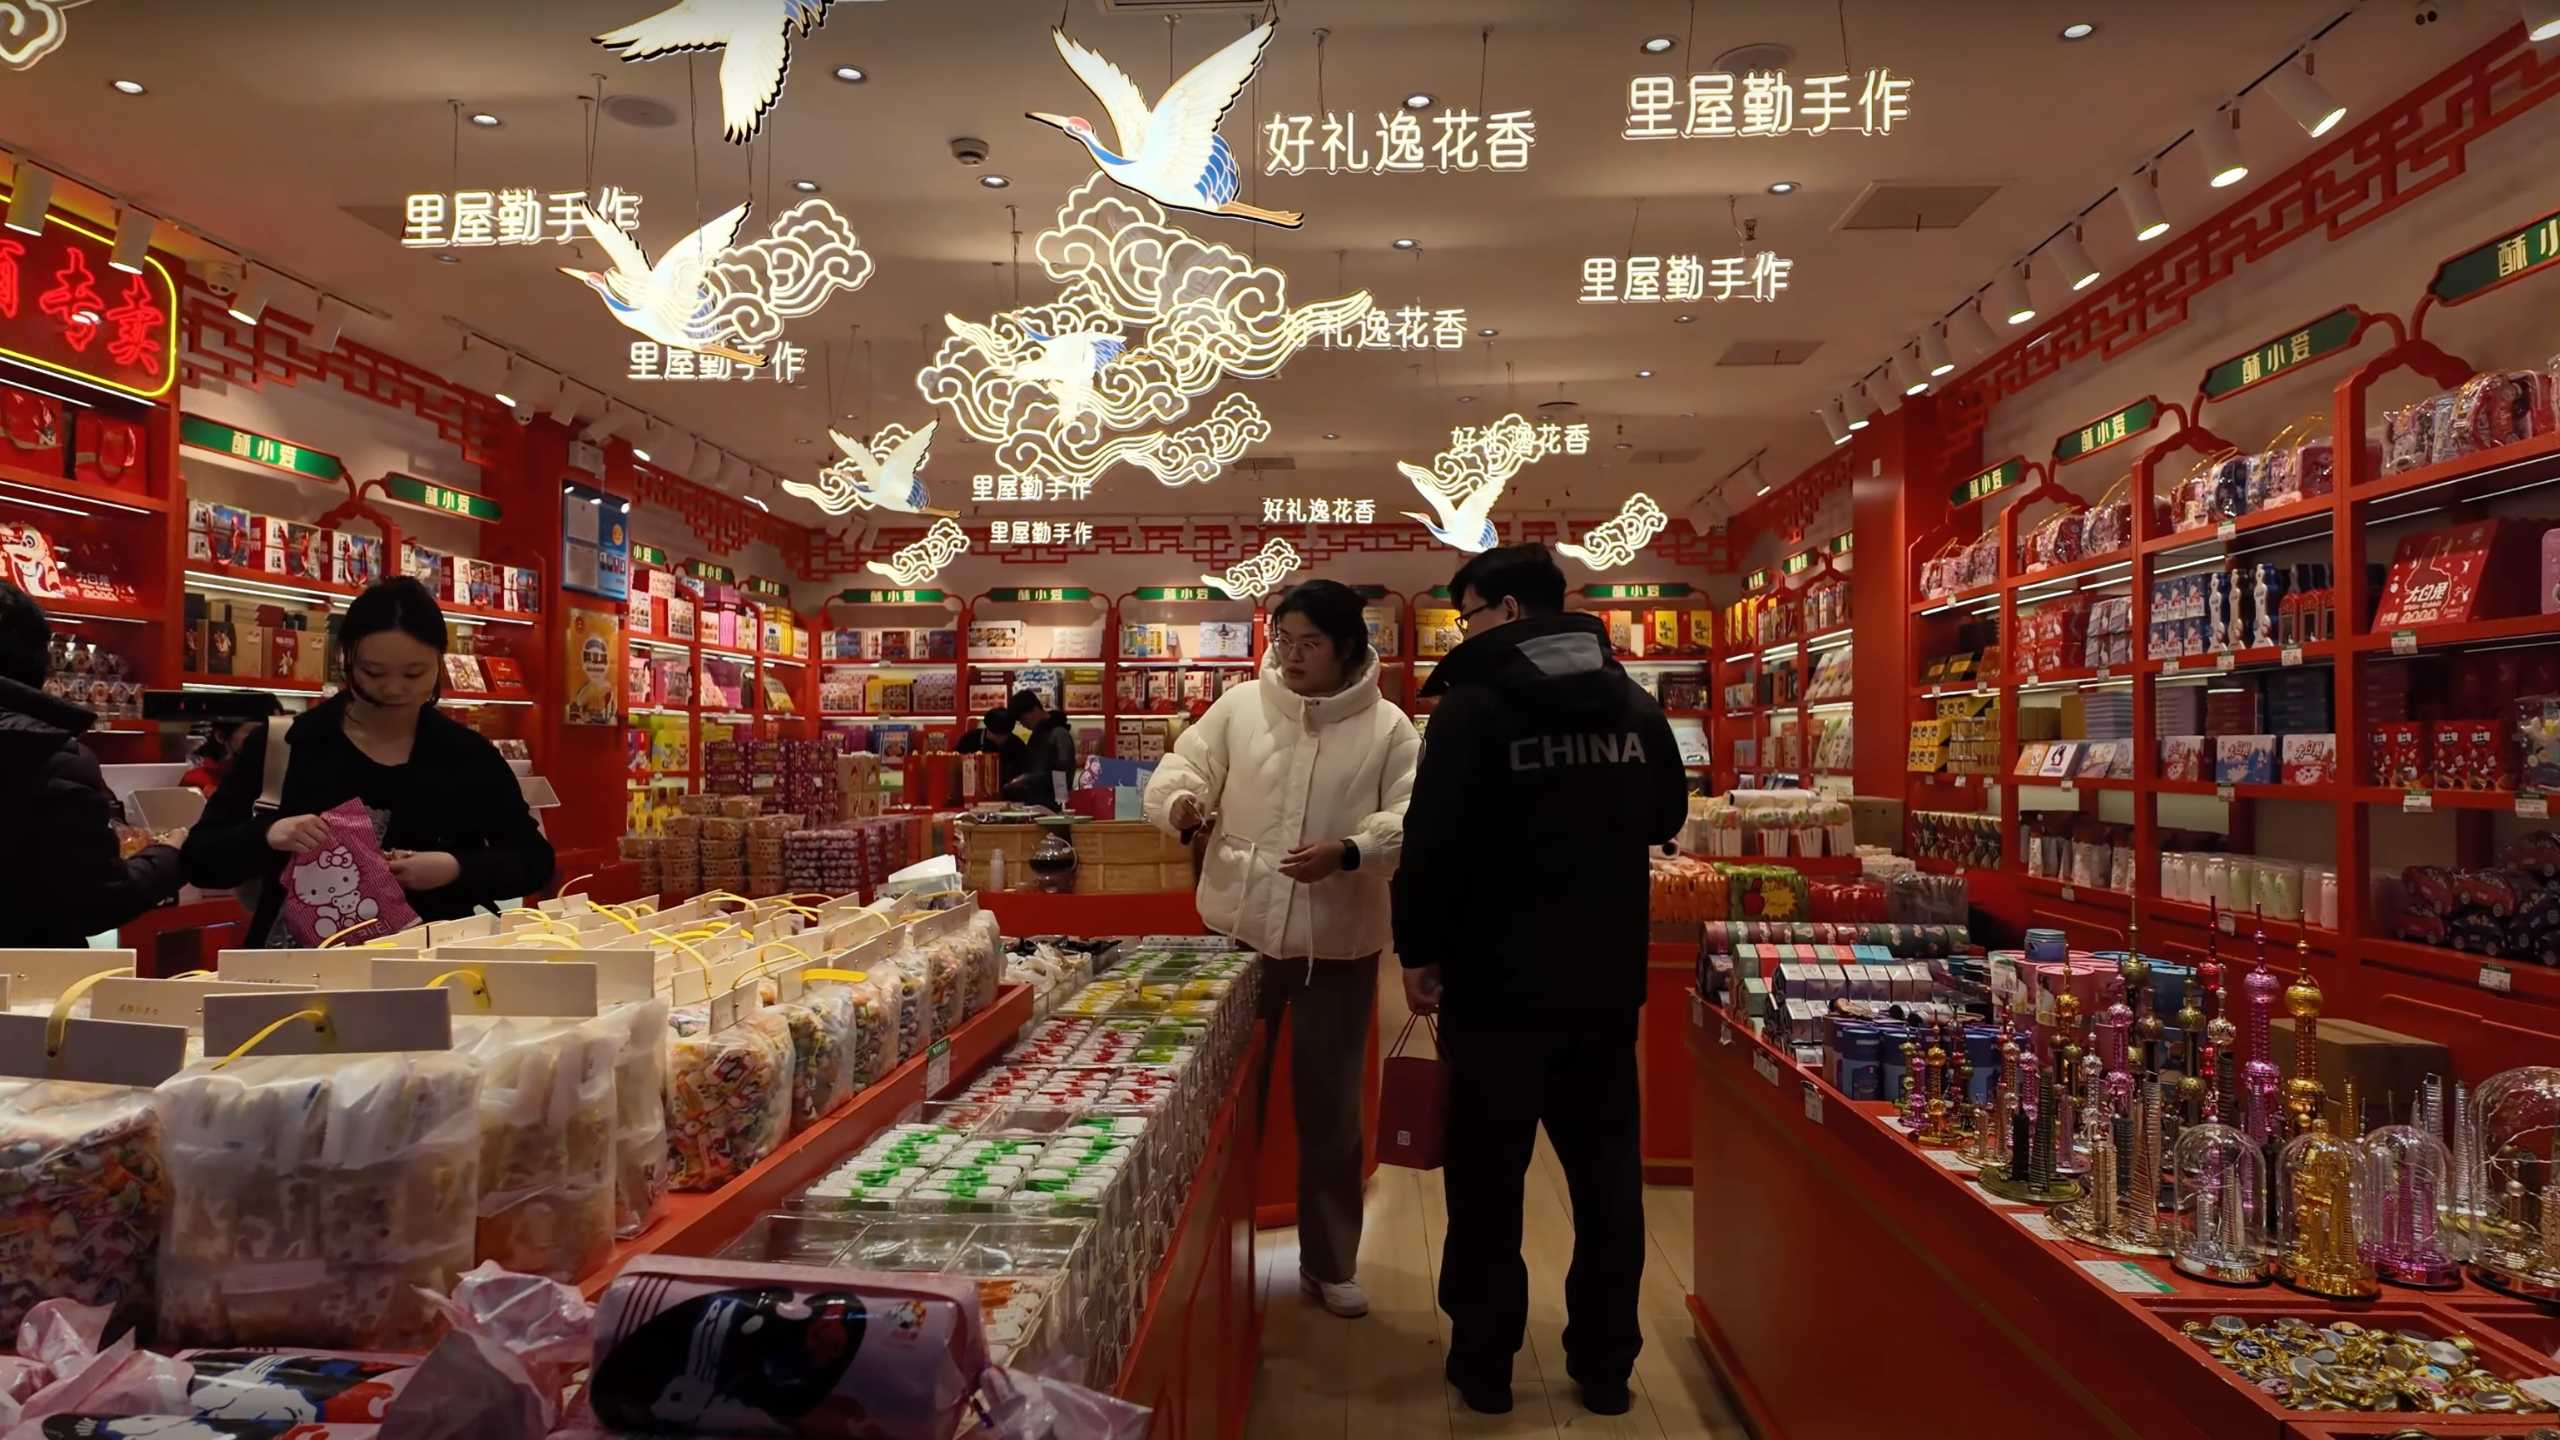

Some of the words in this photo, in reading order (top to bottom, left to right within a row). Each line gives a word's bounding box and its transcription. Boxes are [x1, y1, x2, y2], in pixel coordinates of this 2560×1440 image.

[1624, 72, 1912, 137] 里屋勤手作
[1265, 110, 1537, 174] 好礼逸花香
[401, 187, 642, 246] 里屋勤手作
[1579, 254, 1792, 303] 里屋勤手作
[0, 239, 165, 376] 专卖
[627, 338, 806, 382] 里屋勤手作
[971, 474, 1093, 501] 里屋勤手作
[1262, 497, 1376, 524] 好礼逸花香
[990, 520, 1094, 545] 里屋勤手作
[1510, 732, 1647, 771] CHINA
